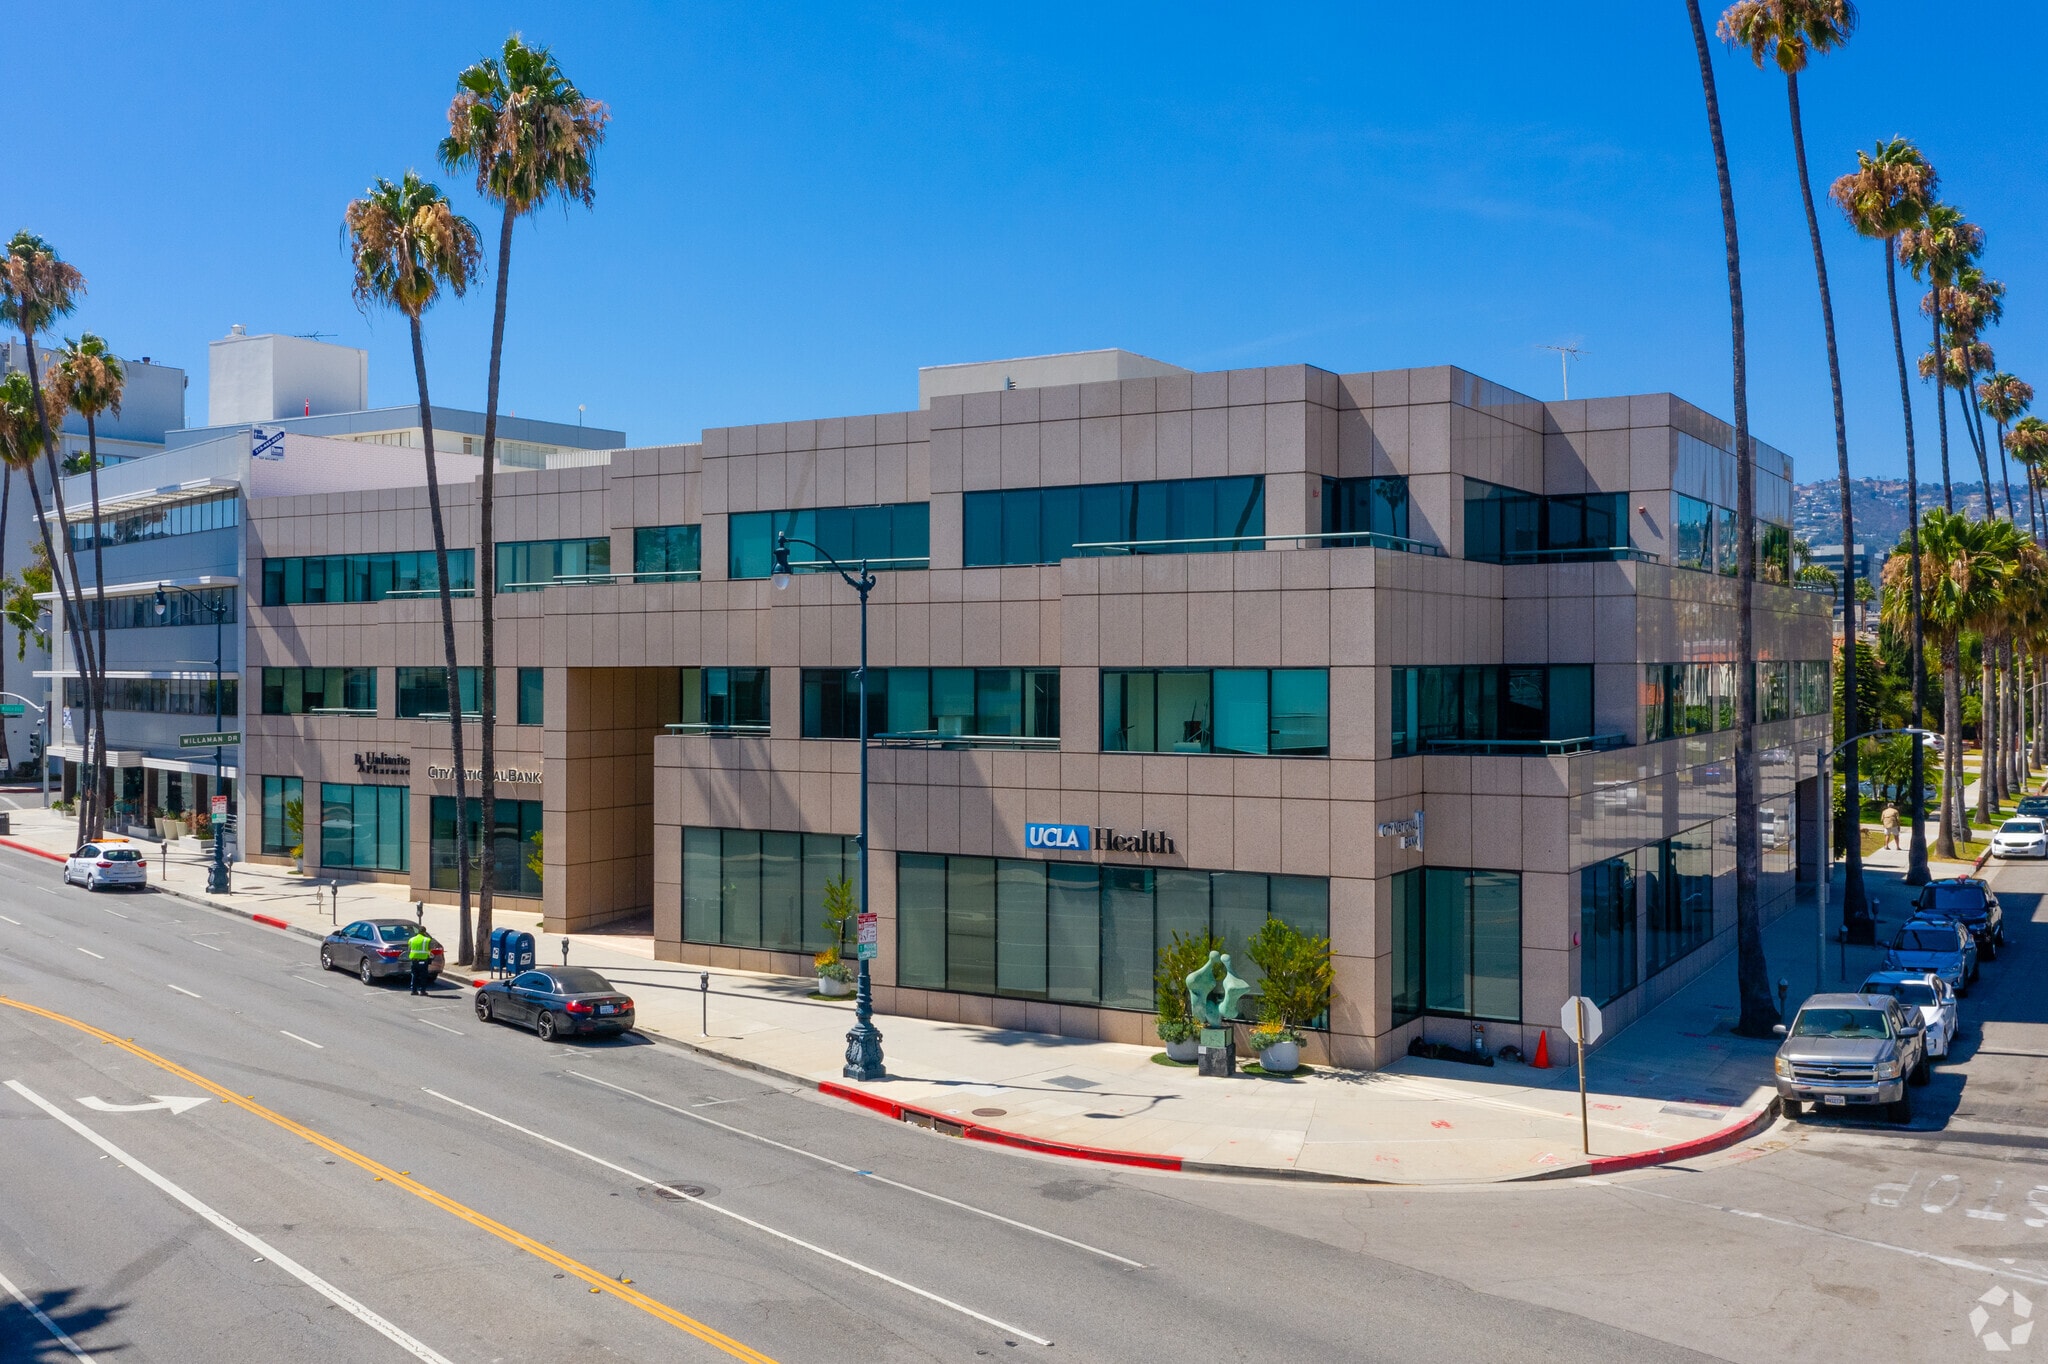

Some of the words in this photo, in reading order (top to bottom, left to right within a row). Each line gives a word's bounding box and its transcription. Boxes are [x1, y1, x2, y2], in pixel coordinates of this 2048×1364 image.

[182, 736, 223, 745] WILLAMAN
[365, 752, 411, 766] Unlimite
[366, 764, 411, 775] Pharmac
[1029, 826, 1080, 848] UCLA
[1093, 826, 1176, 854] Health
